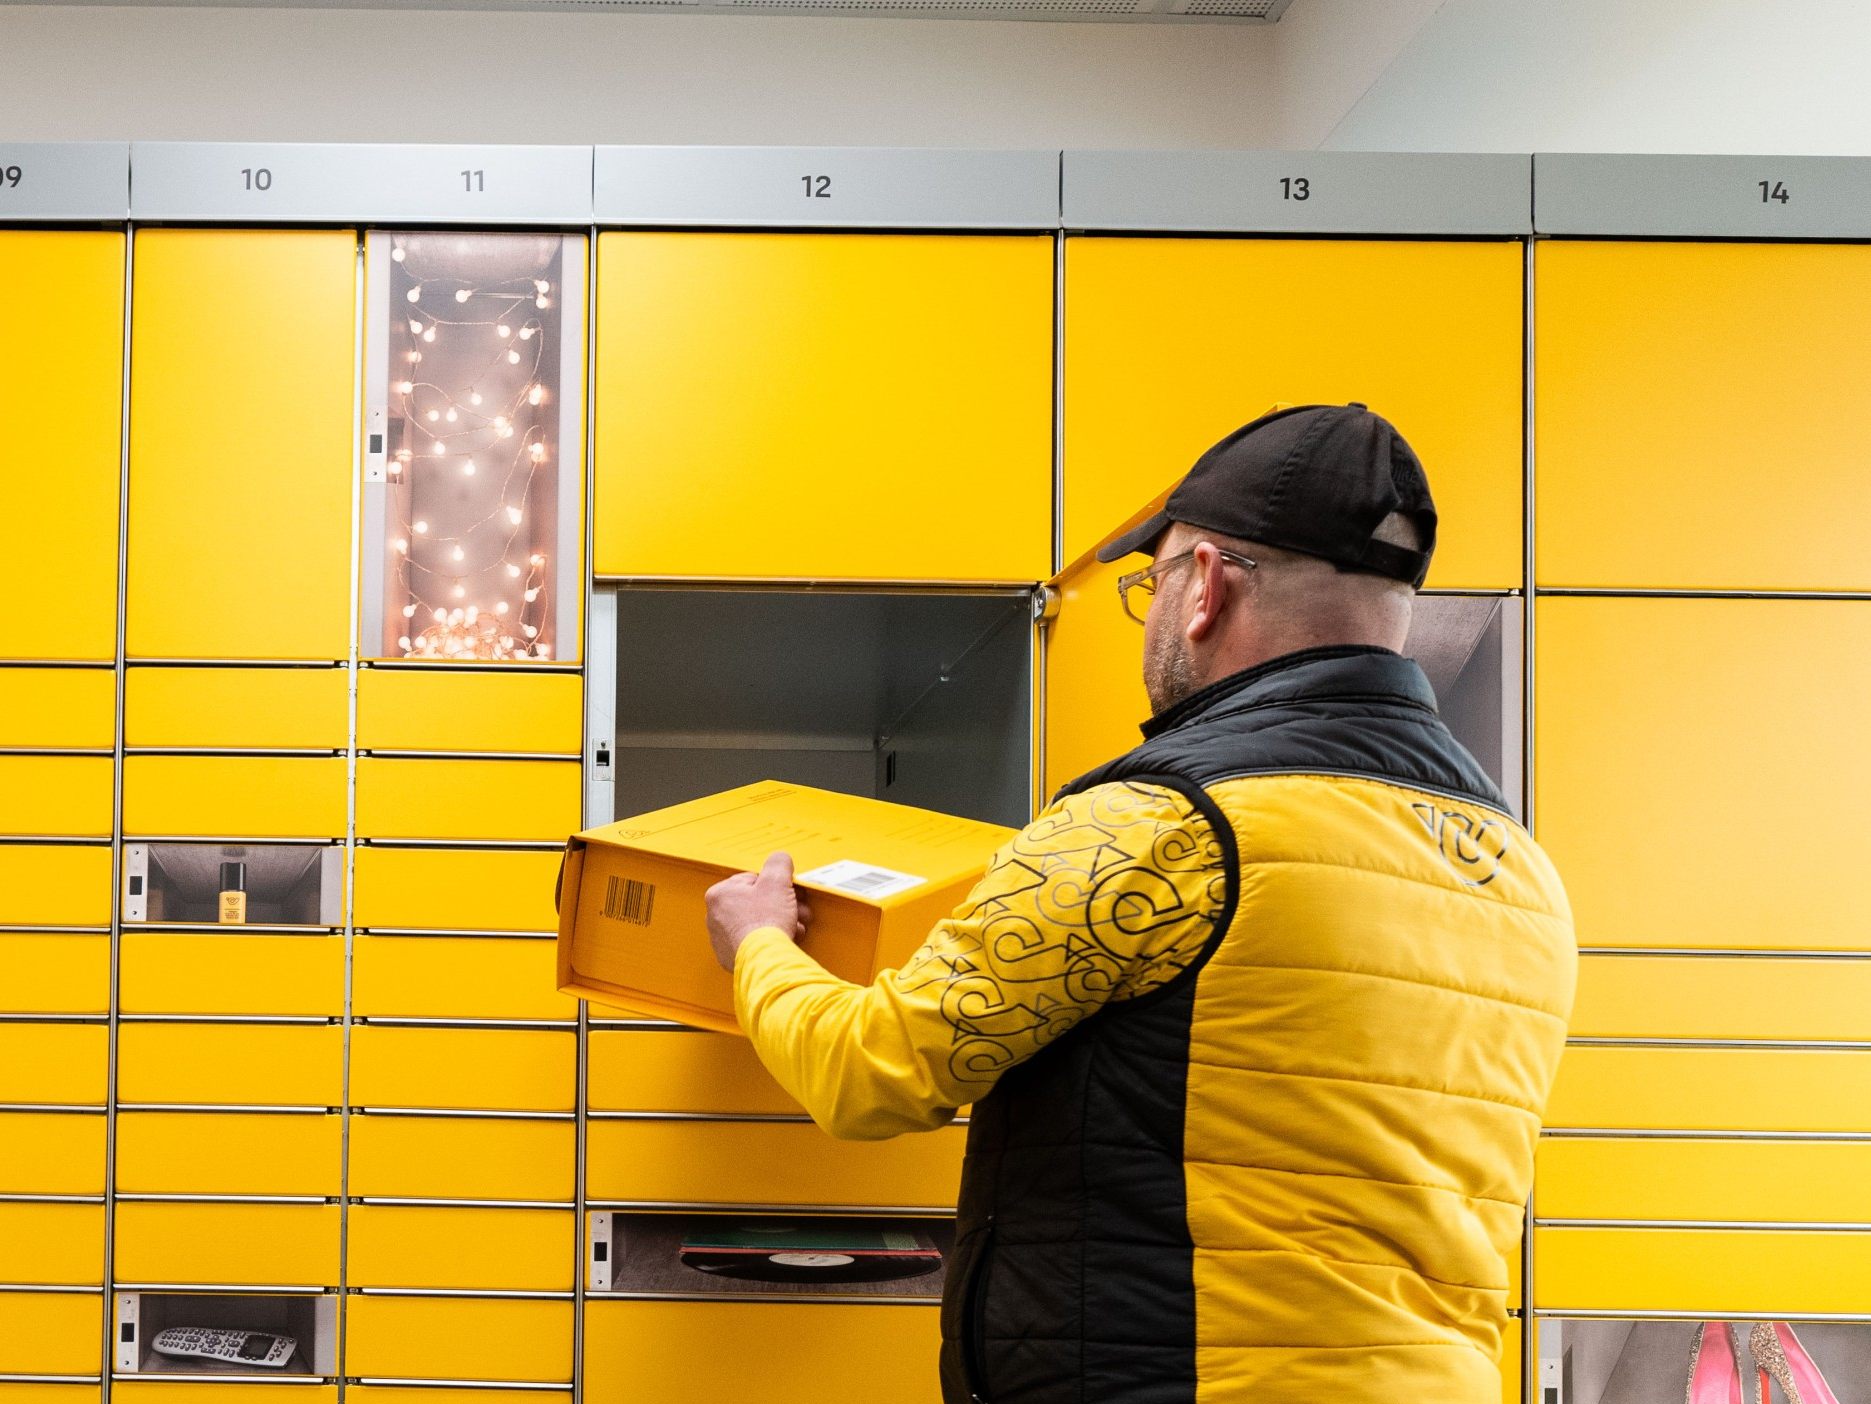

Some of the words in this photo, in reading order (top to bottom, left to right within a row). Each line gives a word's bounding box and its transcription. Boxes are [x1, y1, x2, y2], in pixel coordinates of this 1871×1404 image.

[241, 168, 272, 191] 10
[460, 169, 484, 192] 11
[801, 175, 832, 198] 12
[1279, 177, 1310, 201] 13
[1758, 180, 1791, 205] 14
